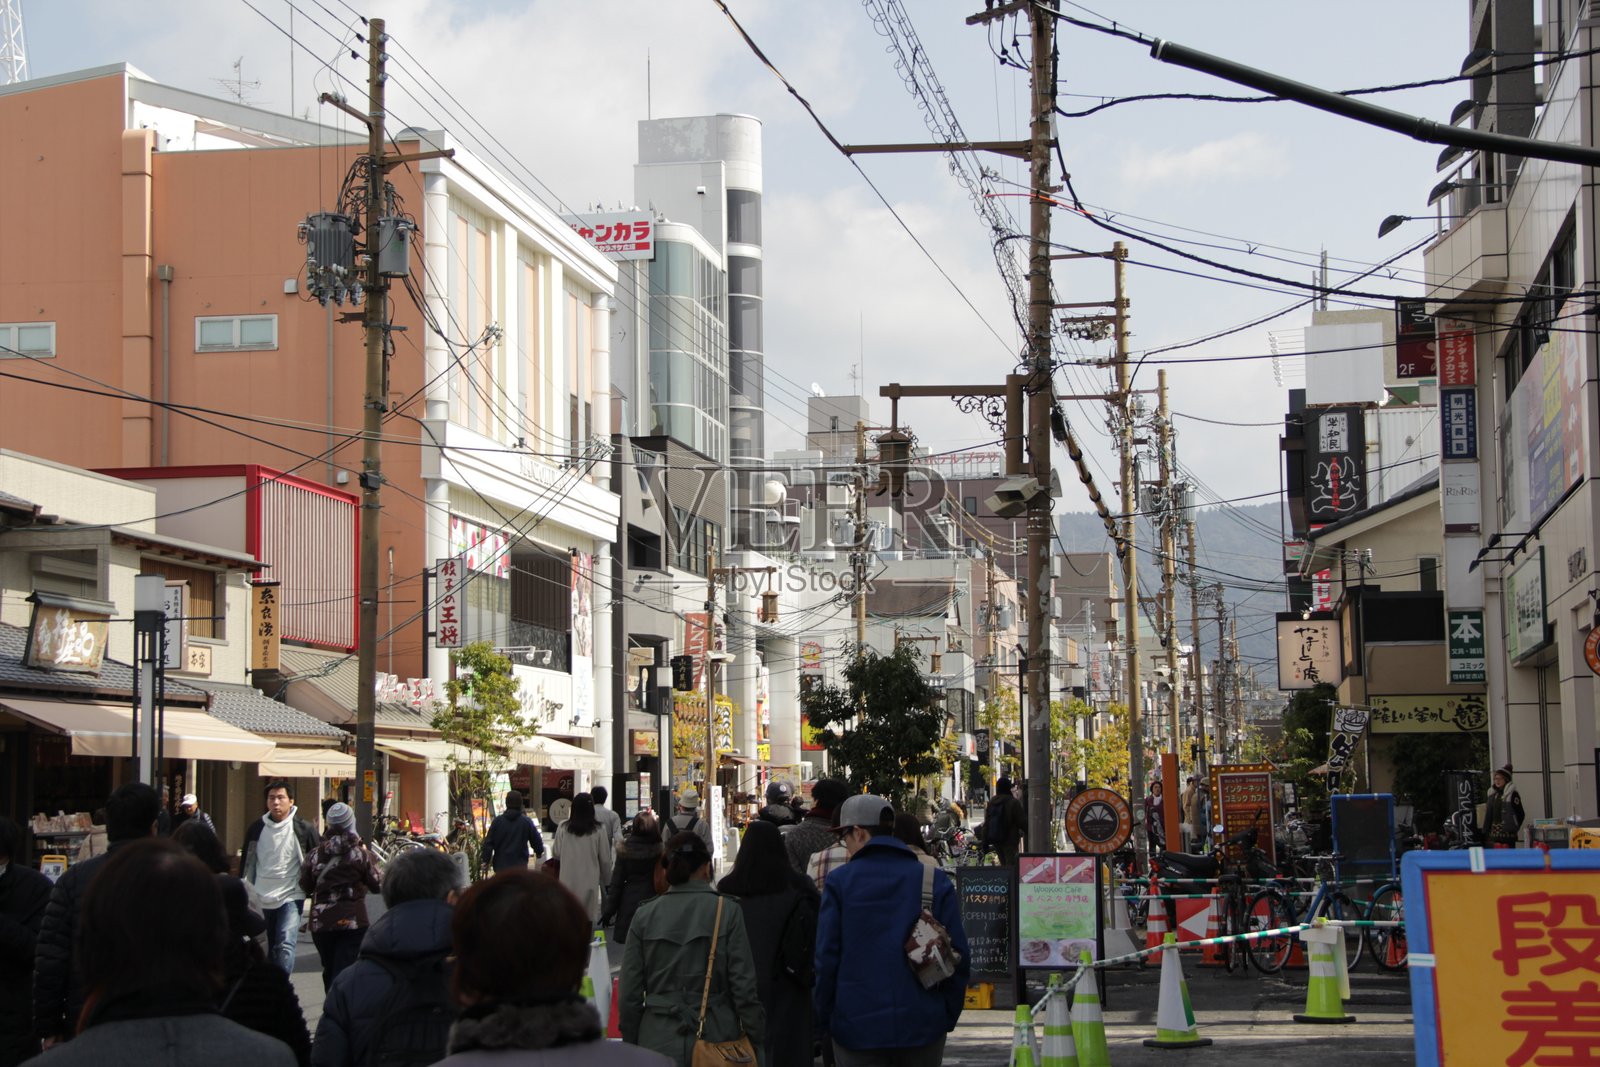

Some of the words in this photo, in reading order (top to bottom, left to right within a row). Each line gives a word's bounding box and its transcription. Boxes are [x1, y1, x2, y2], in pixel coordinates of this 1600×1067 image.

[1399, 363, 1415, 375] 2F
[259, 588, 275, 636] 奈良漬
[440, 560, 458, 645] 餃子の王将
[1451, 614, 1481, 643] 本
[1492, 891, 1600, 1067] 段差
